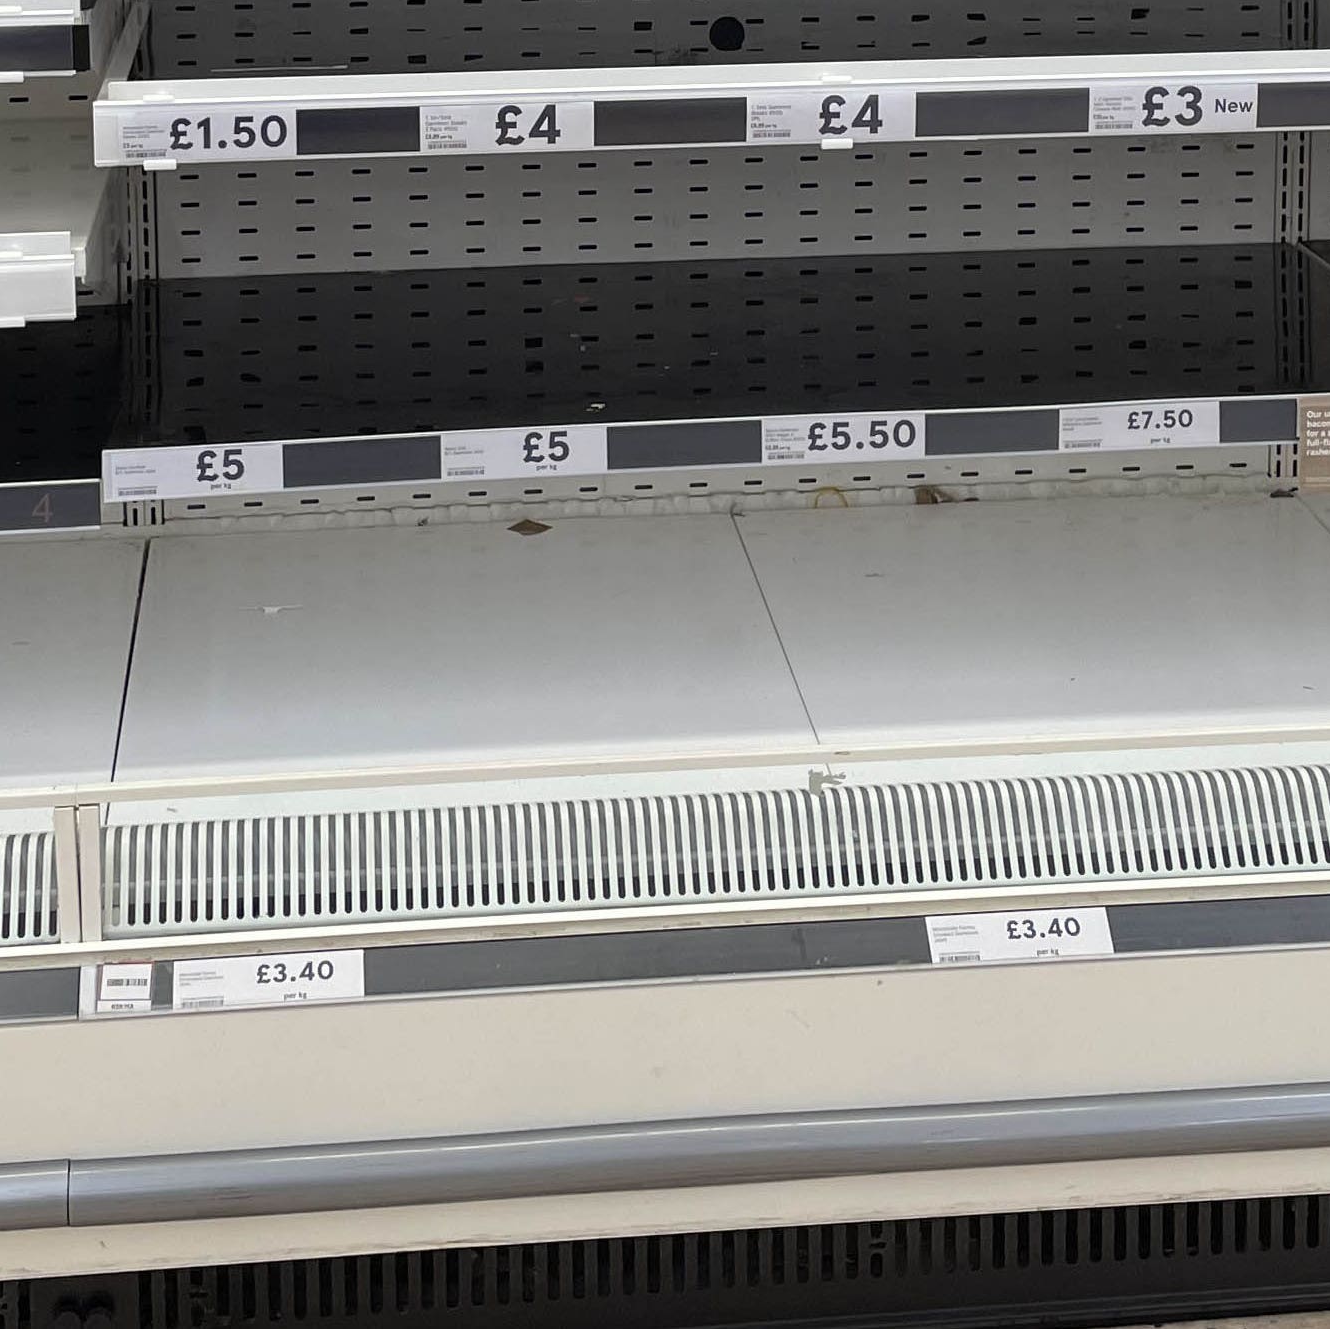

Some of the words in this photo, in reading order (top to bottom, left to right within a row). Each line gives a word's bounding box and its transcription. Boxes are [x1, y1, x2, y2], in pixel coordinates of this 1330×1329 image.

[819, 95, 882, 135] £4
[1142, 86, 1202, 126] £3
[1215, 99, 1253, 113] New
[170, 115, 287, 150] £1.50
[495, 105, 560, 145] £4
[1128, 409, 1192, 429] £7.50
[1307, 410, 1321, 418] Our
[1307, 420, 1330, 428] bacon
[808, 420, 915, 451] £5.50
[1307, 430, 1319, 438] for
[523, 431, 569, 462] £5
[196, 449, 244, 481] £5
[536, 464, 547, 472] per
[549, 463, 557, 472] kg
[210, 483, 221, 491] per
[223, 481, 231, 490] kg
[1007, 918, 1080, 939] £3.40
[1037, 949, 1048, 957] per
[1050, 947, 1059, 956] kg
[257, 961, 333, 983] £3.40
[283, 992, 296, 1002] per
[298, 991, 307, 1001] kg
